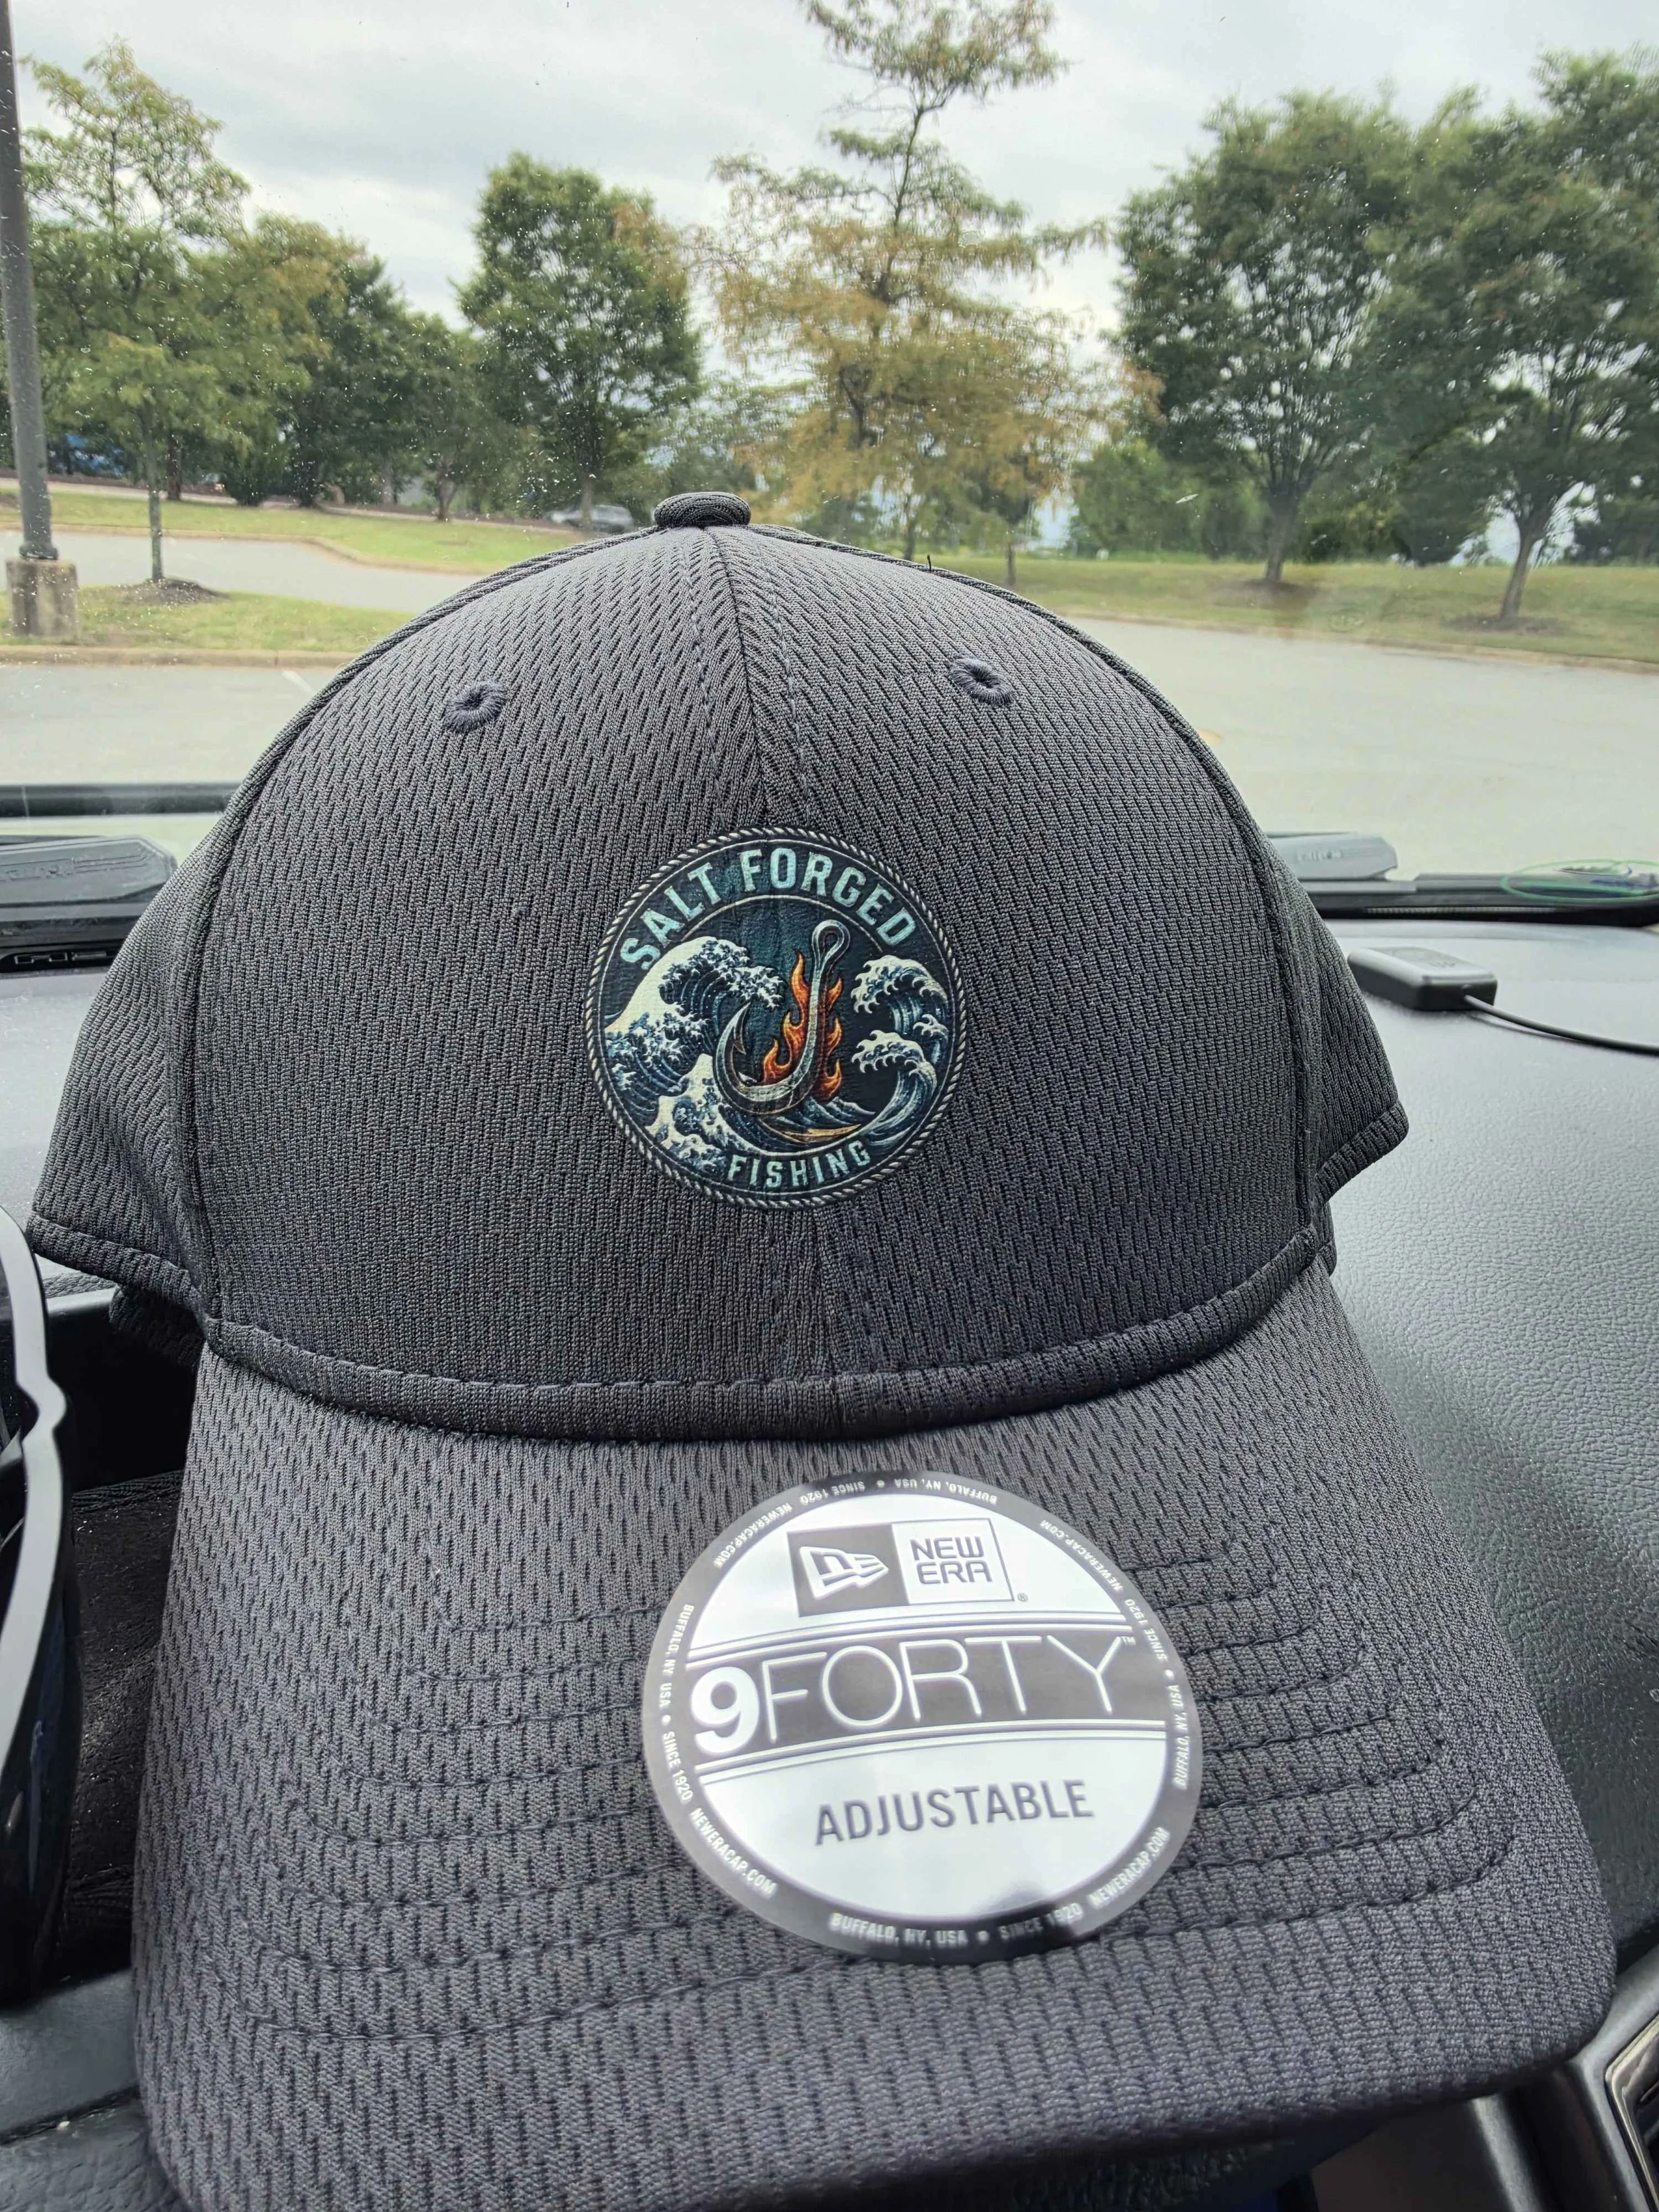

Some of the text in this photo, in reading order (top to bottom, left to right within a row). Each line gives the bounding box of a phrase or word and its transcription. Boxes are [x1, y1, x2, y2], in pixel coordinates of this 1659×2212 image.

[620, 848, 916, 970] SALT FORGED
[728, 1140, 869, 1187] FISHING
[800, 1489, 829, 1505] 1920
[831, 1481, 865, 1495] SINCE
[895, 1479, 917, 1489] USA
[946, 1481, 997, 1505] BUFFALO,
[713, 1503, 793, 1568] NEWERACAP.COM
[910, 1536, 984, 1560] NEW
[916, 1560, 992, 1584] ERA
[1040, 1520, 1123, 1591] NEWERACAP.COM
[1125, 1599, 1149, 1625] 1920
[1144, 1628, 1168, 1662] SINCE
[659, 1682, 672, 1708] USA
[691, 1635, 1123, 1753] 9FORTY
[1168, 1684, 1184, 1708] USA
[664, 1731, 682, 1768] SINCE
[673, 1769, 693, 1803] 1920
[815, 1779, 1094, 1846] ADJUSTABLE
[690, 1807, 778, 1896] NEWERACAP.COM
[934, 1929, 969, 1947] USA
[1088, 1826, 1171, 1909] NEWERACAP.COM
